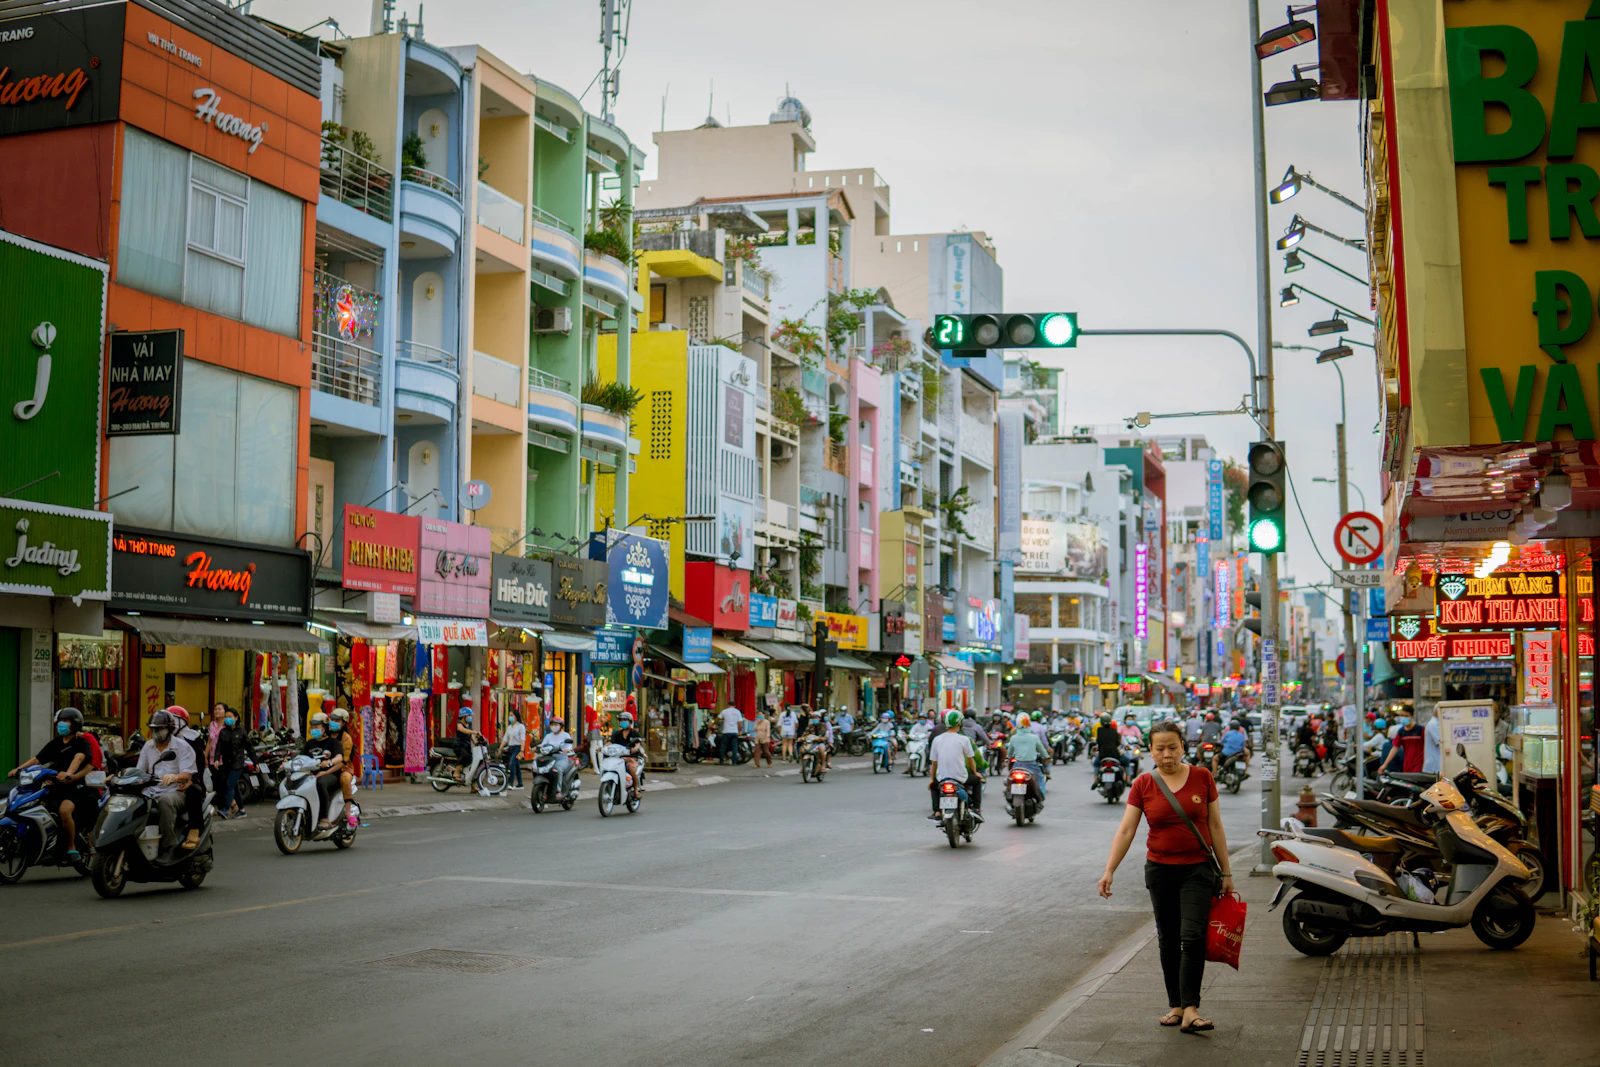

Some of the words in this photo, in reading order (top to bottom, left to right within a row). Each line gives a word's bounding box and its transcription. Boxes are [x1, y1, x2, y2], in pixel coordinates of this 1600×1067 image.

[178, 47, 202, 68] TRANG
[1533, 270, 1600, 348] Đ
[940, 319, 963, 344] 21
[133, 335, 154, 358] VẢI
[112, 361, 140, 382] NHÀ
[143, 365, 172, 382] MAY
[1480, 344, 1600, 443] VÀ
[149, 542, 176, 558] TRANG
[349, 540, 381, 568] MINH
[183, 551, 253, 604] Hương
[1466, 576, 1507, 599] TIỆM
[1509, 573, 1553, 595] VÀNG
[1441, 600, 1482, 624] KIM
[1485, 598, 1559, 623] THANH
[443, 622, 459, 642] QUẾ
[461, 628, 476, 640] ANH
[35, 648, 50, 660] 299
[1395, 636, 1446, 658] TUYẾT
[1453, 638, 1512, 657] NHUNG
